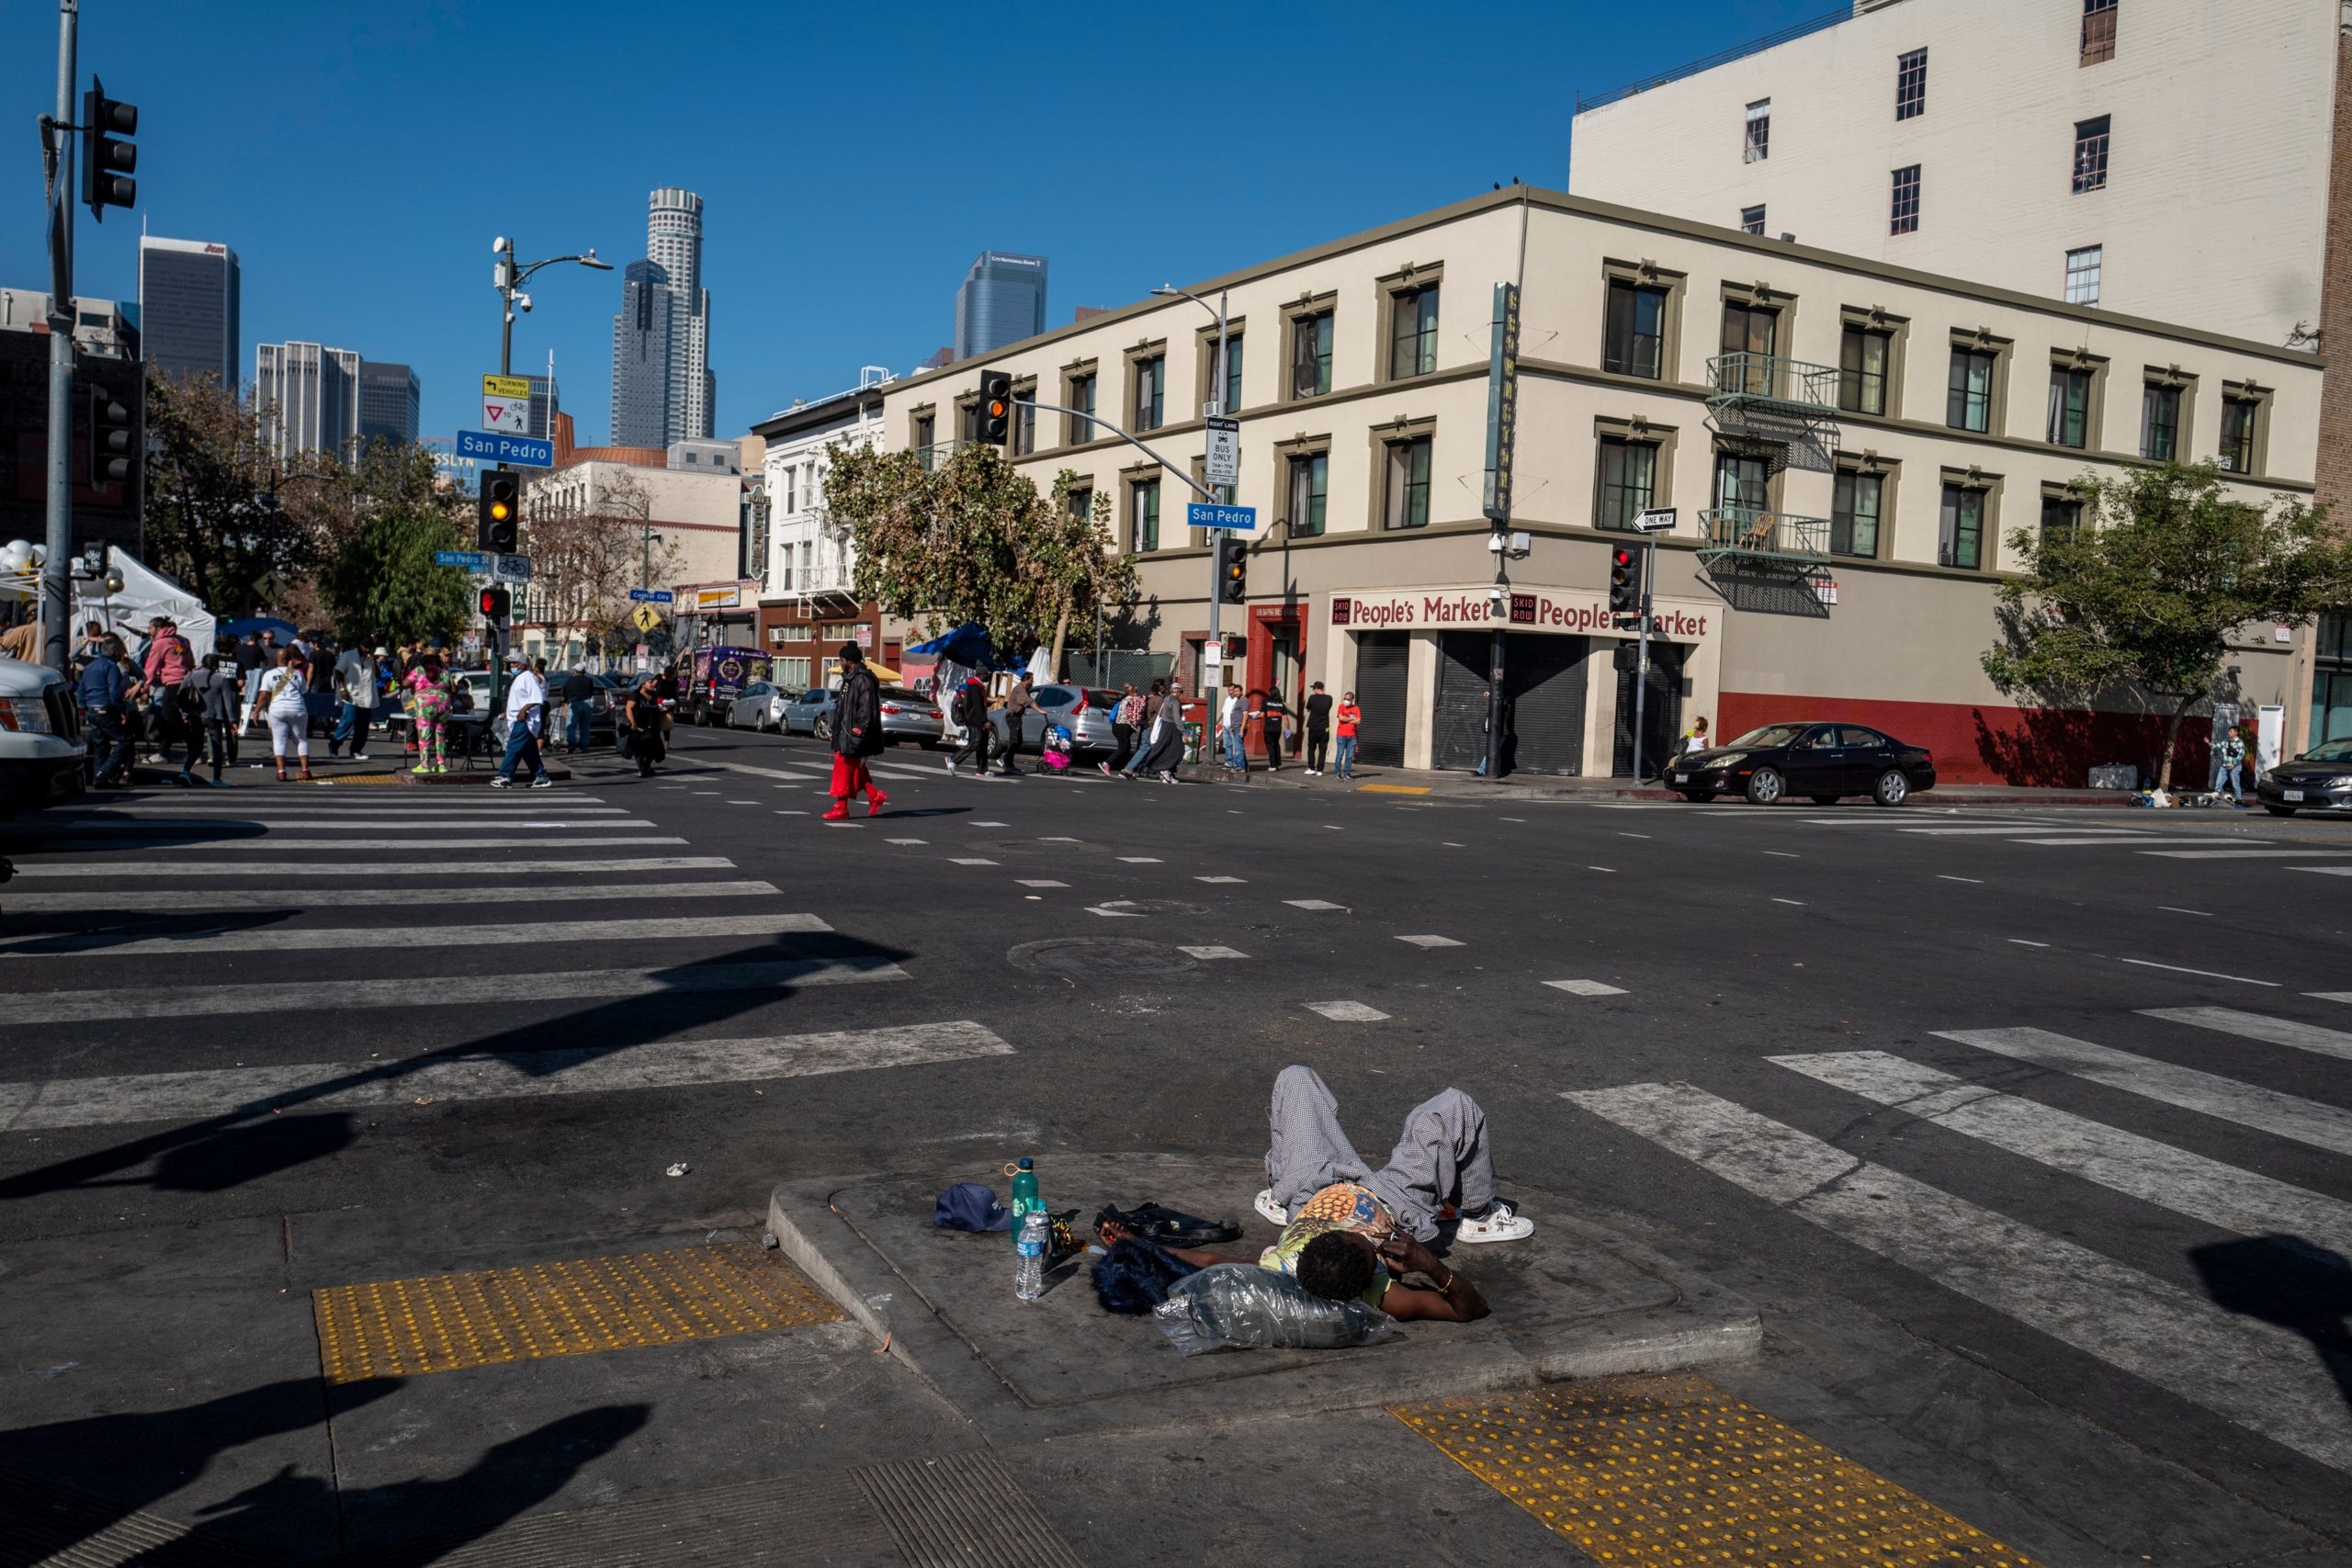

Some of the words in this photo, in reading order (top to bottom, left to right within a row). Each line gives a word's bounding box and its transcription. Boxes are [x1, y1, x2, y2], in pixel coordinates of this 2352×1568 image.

[500, 379, 526, 389] TURNING
[498, 388, 528, 397] VEHICLES
[464, 436, 494, 454] San
[500, 441, 547, 459] Pedro
[1215, 445, 1230, 453] BUS
[1213, 453, 1232, 461] ONLY
[1193, 508, 1214, 521] San
[1217, 510, 1250, 524] Pedro
[1645, 516, 1657, 525] ONE
[1659, 514, 1672, 523] WAY
[439, 553, 454, 562] San
[457, 555, 478, 563] Pedro
[1334, 602, 1349, 611] SKID
[1513, 597, 1533, 608] SKID
[1353, 599, 1414, 627] People's
[1424, 596, 1490, 622] Market
[1513, 610, 1533, 620] ROW
[1334, 613, 1349, 621] ROW
